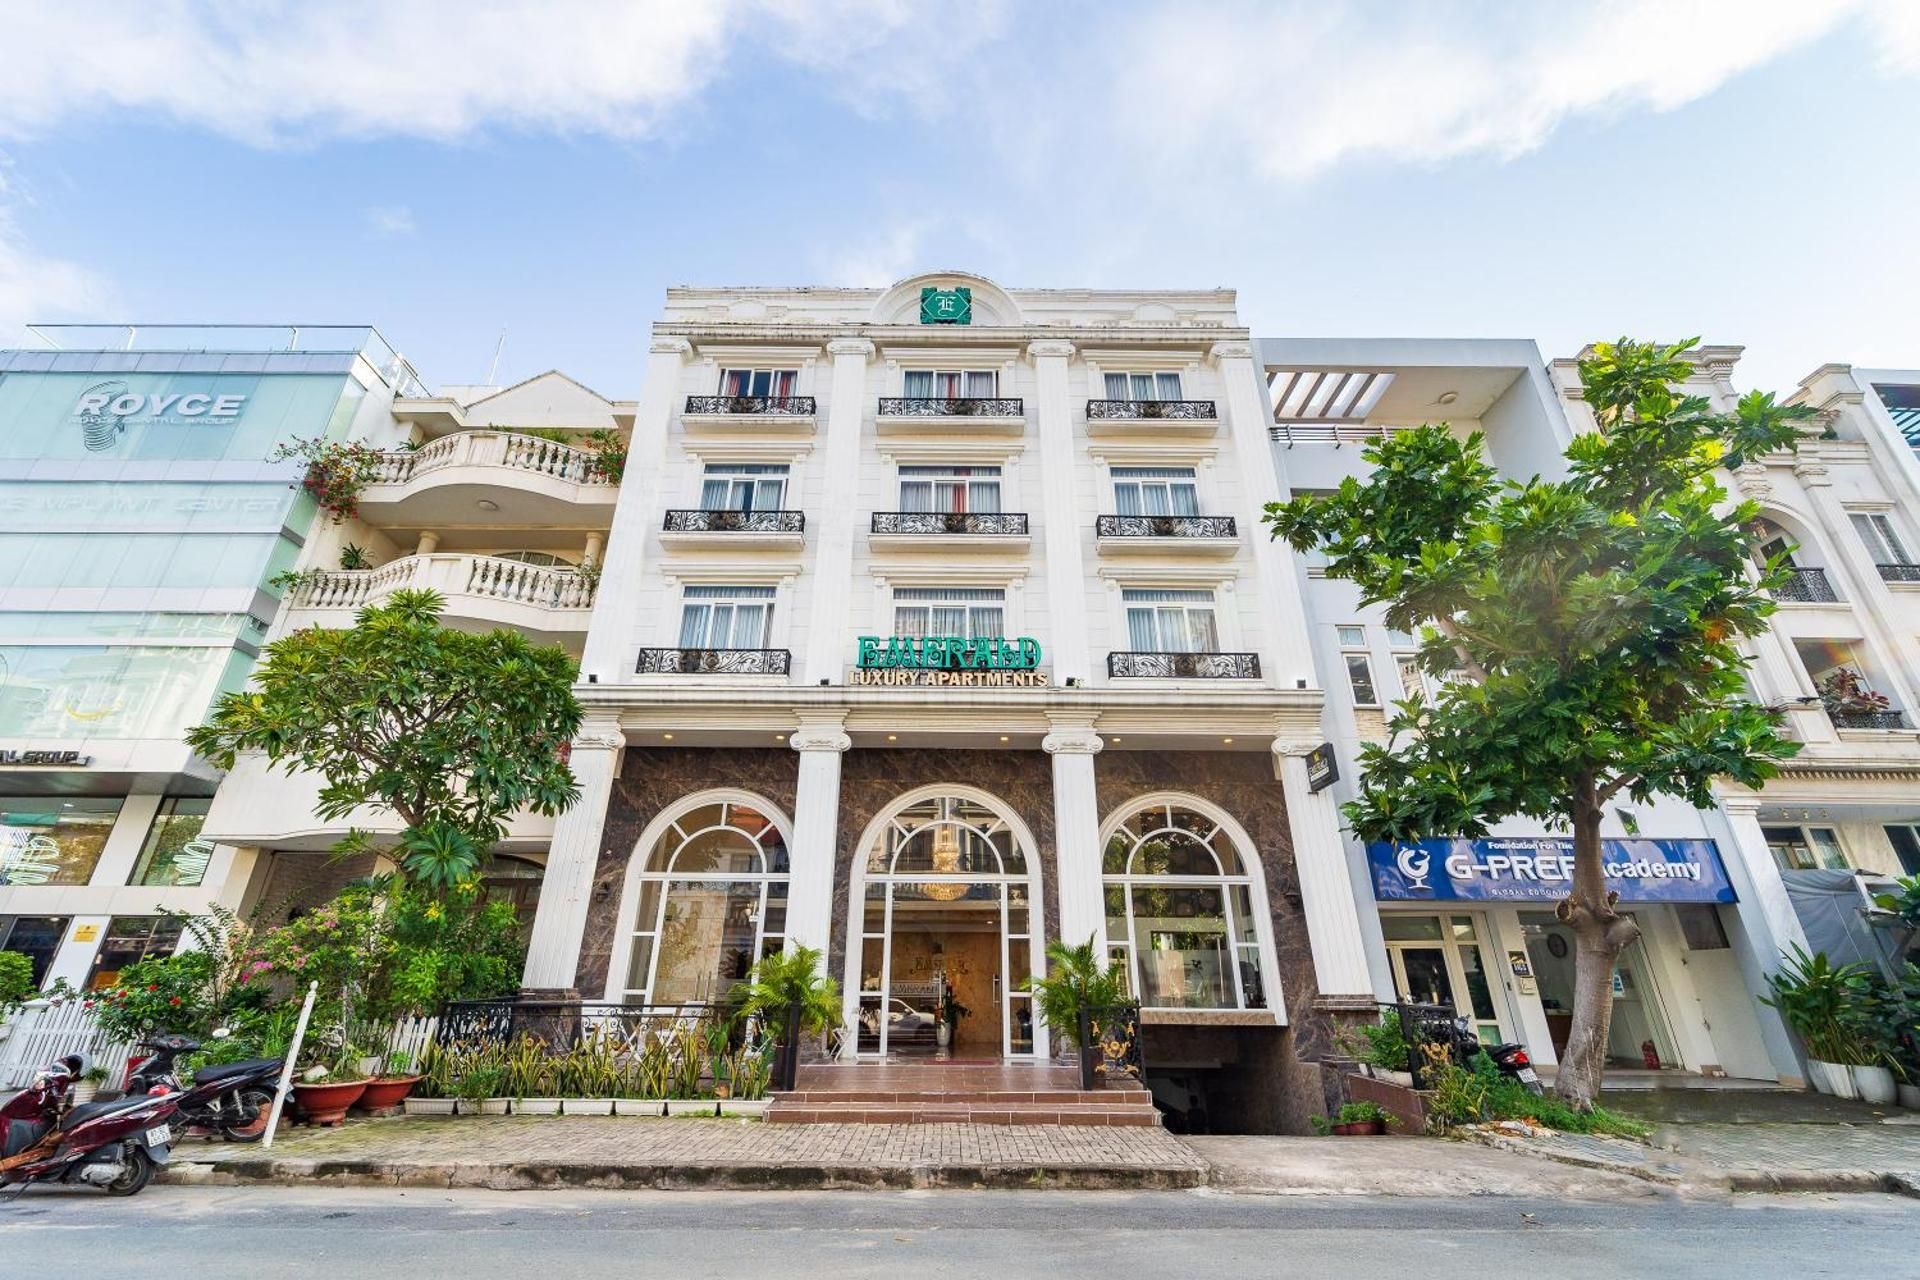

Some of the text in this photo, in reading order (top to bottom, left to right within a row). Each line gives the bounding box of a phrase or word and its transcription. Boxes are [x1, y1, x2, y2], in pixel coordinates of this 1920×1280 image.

[72, 393, 247, 416] ROYCE
[855, 636, 1042, 669] EMERALD
[850, 671, 1048, 686] LUXURY APARTMENTS
[1487, 842, 1539, 850] Foundation
[1540, 842, 1556, 850] For
[1602, 858, 1701, 881] cademy
[1491, 888, 1525, 897] GLOBAL
